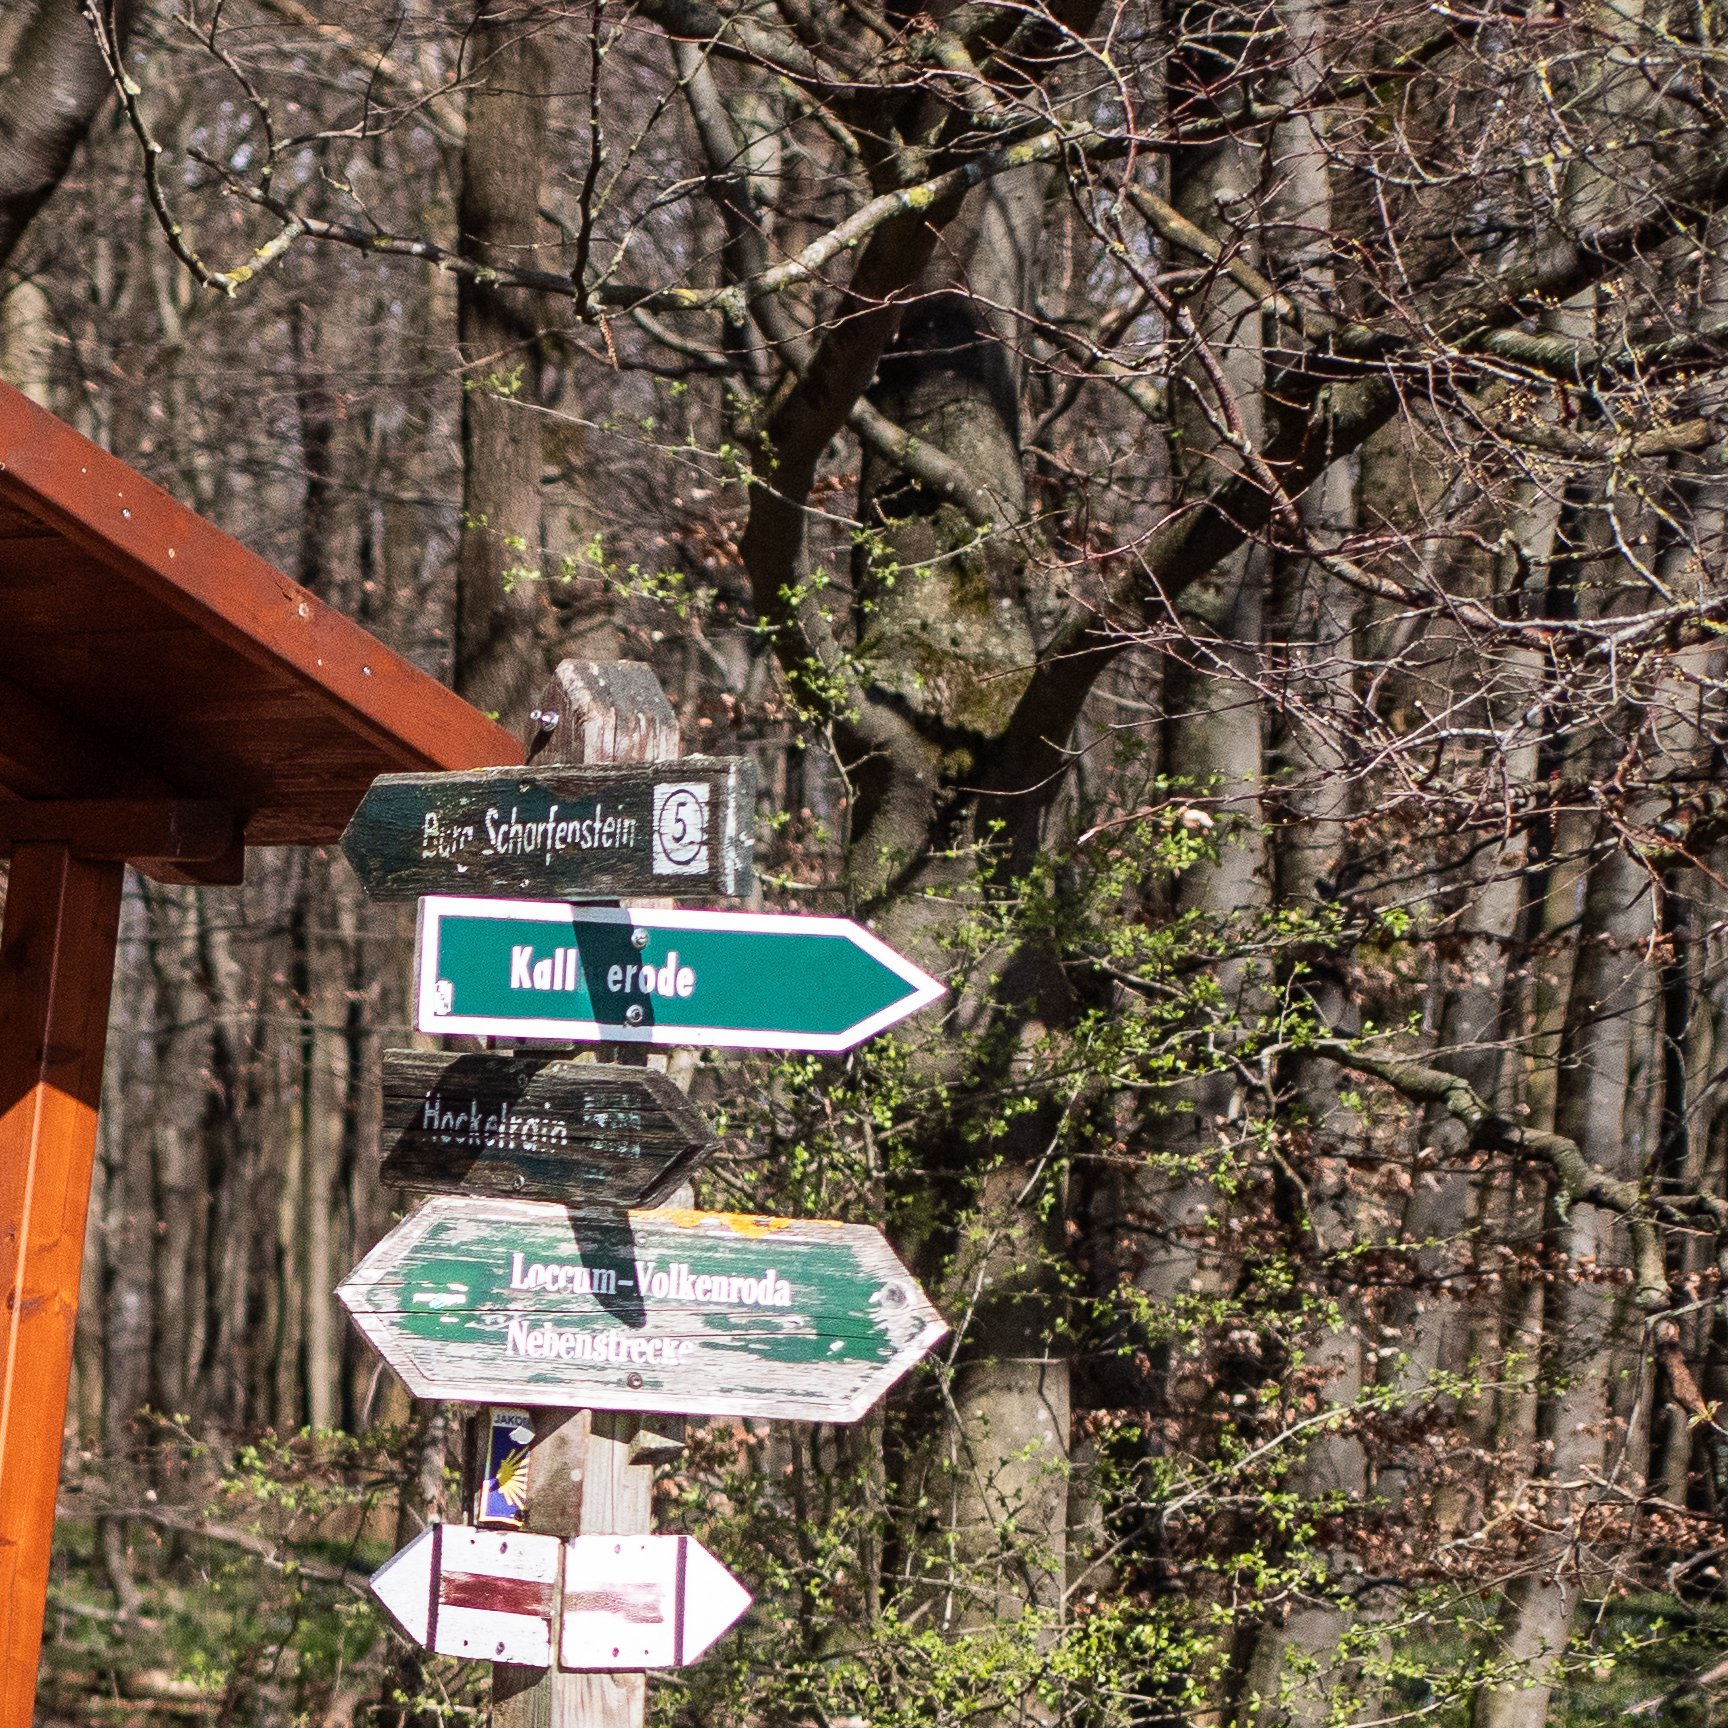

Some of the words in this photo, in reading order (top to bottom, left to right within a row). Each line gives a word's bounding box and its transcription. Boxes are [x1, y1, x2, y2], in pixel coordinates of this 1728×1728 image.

[482, 803, 637, 866] Scharfenstein
[672, 801, 687, 843] 5
[510, 1252, 791, 1306] Loccum-Volkenroda
[506, 1319, 696, 1364] Nebenstrecke
